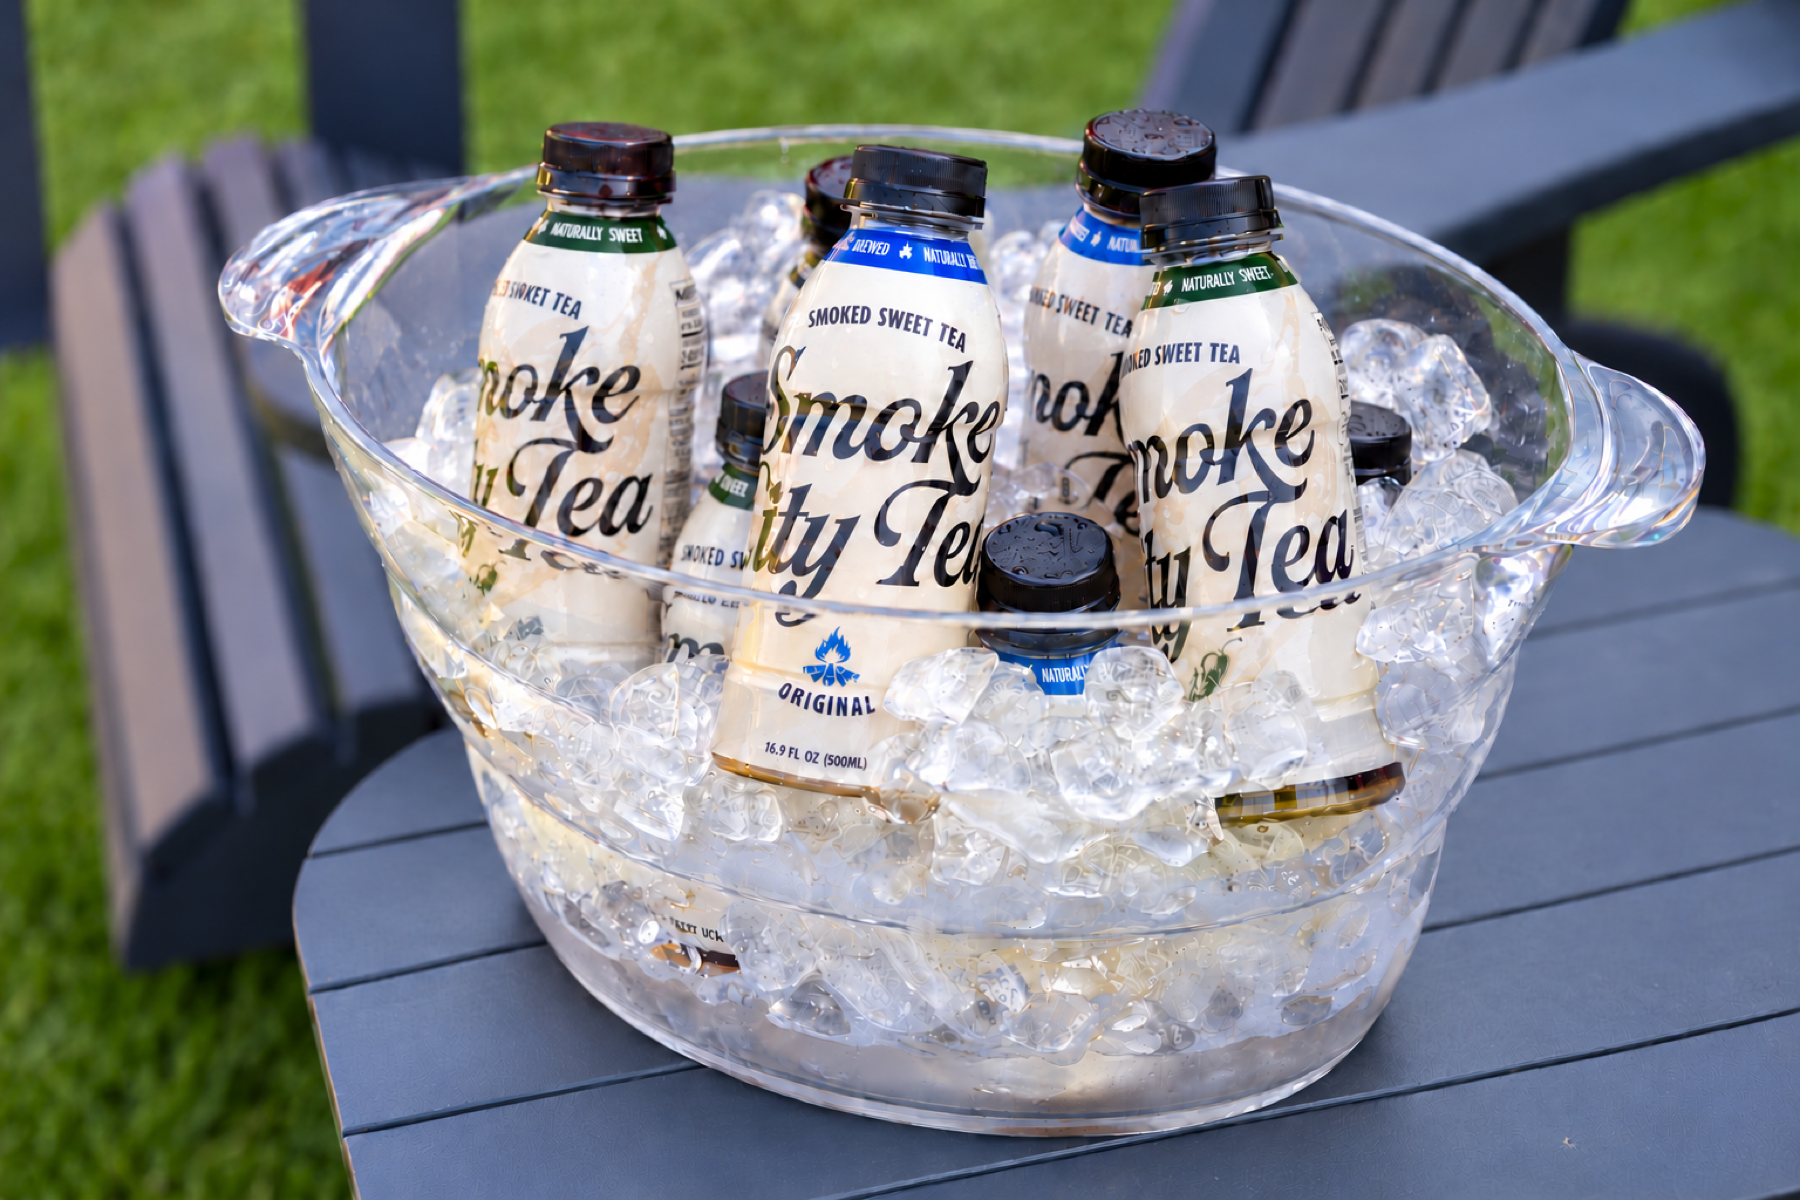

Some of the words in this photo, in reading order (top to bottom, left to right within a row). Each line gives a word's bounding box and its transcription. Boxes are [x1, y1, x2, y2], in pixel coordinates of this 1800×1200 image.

[550, 222, 603, 241] NATURALLY
[608, 227, 643, 243] SWEET
[1181, 271, 1235, 293] NATURALLY
[1239, 266, 1272, 283] SWEET
[552, 292, 582, 320] TEA
[1056, 294, 1101, 326] SWEET
[1105, 312, 1134, 339] TEA
[808, 305, 872, 329] SMOKED
[877, 307, 933, 337] SWEET
[938, 322, 967, 353] TEA
[1154, 341, 1202, 366] SWEET
[1210, 342, 1240, 364] TEA
[763, 345, 1001, 497] Smoke
[500, 437, 653, 558] Tea
[1202, 490, 1355, 632] Tea
[778, 682, 876, 717] ORIGINAL
[765, 741, 786, 756] 16.9
[788, 746, 800, 760] FL
[804, 750, 820, 764] OZ
[823, 753, 868, 771] (500ML)
